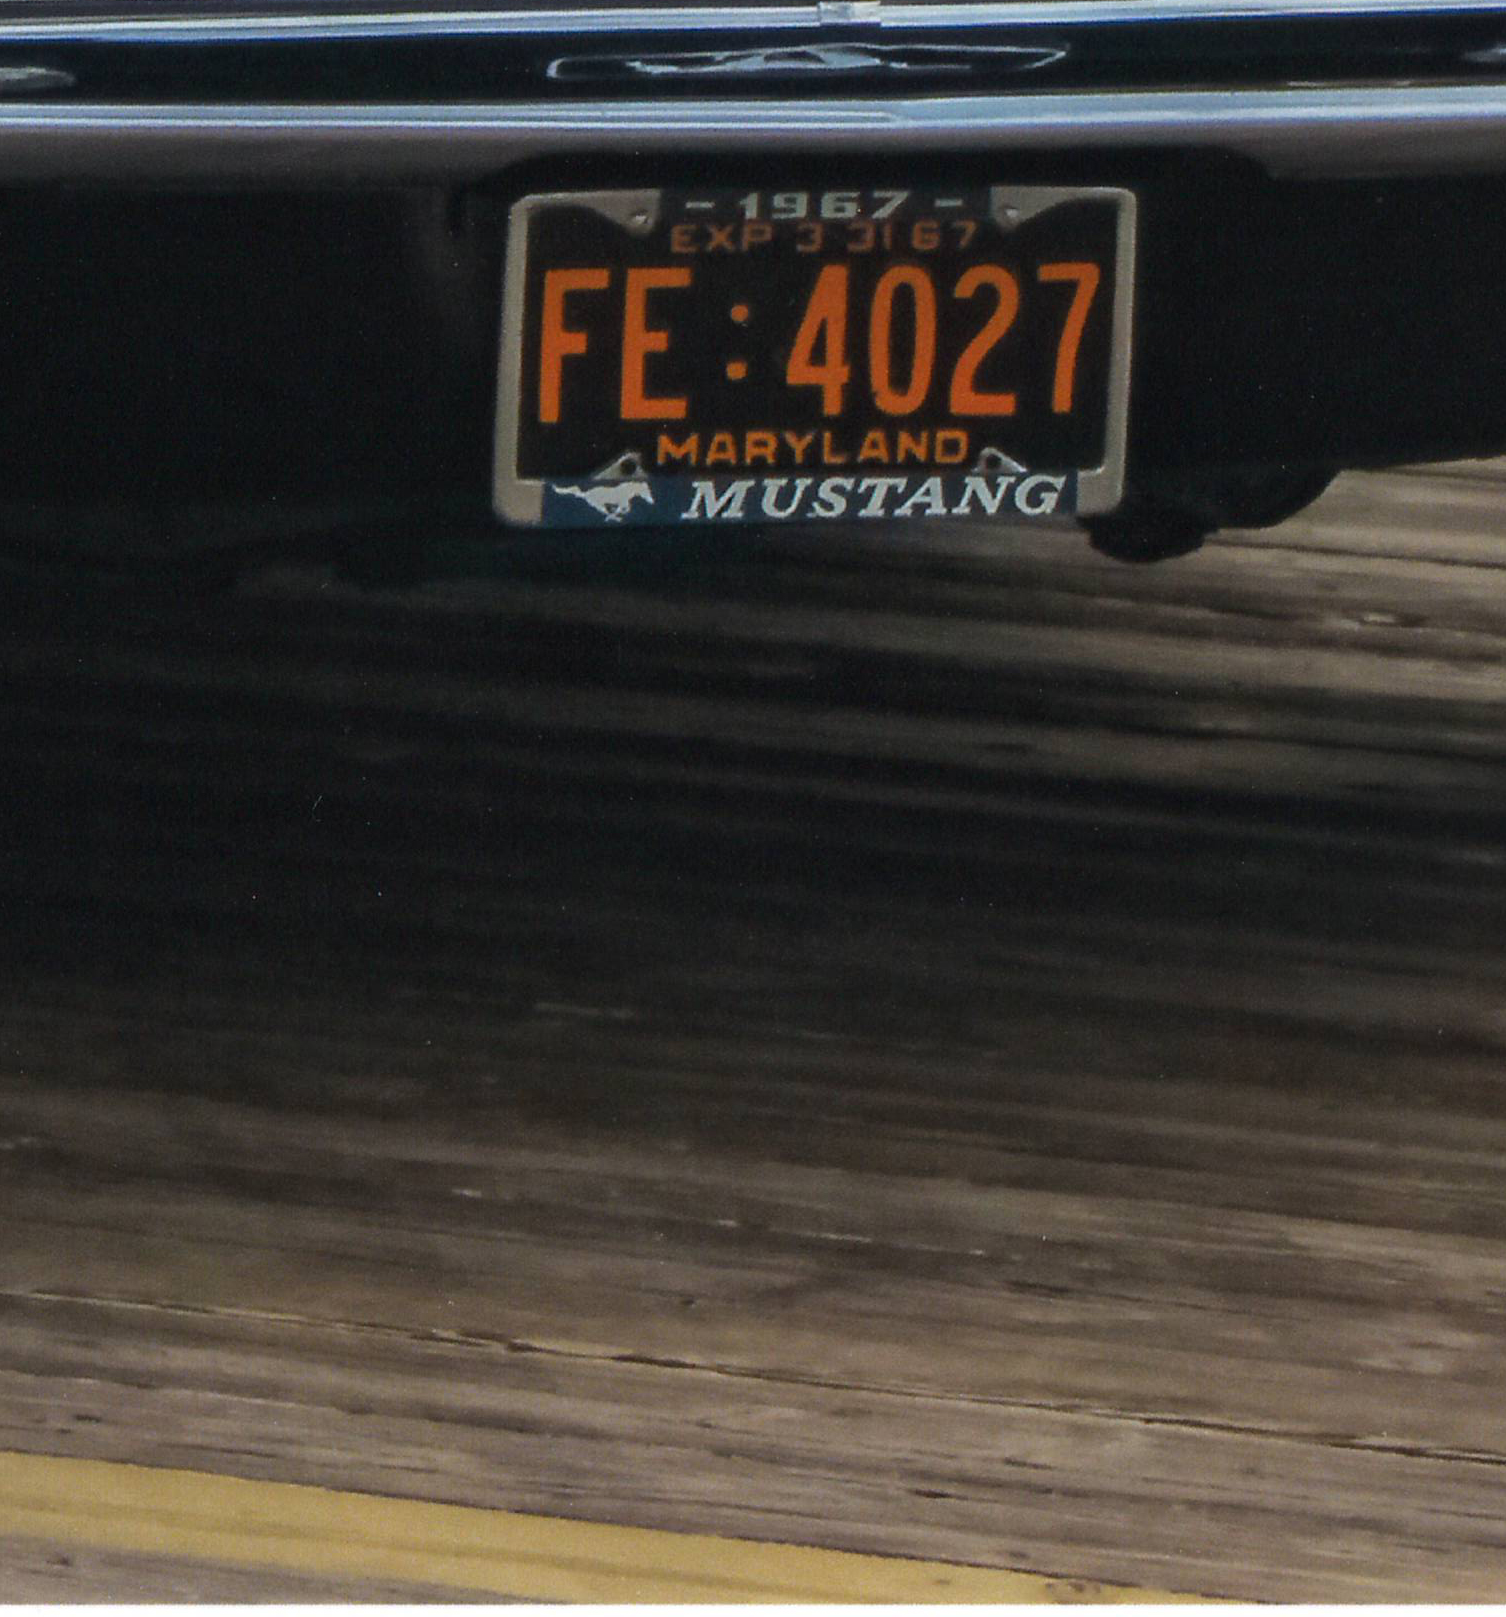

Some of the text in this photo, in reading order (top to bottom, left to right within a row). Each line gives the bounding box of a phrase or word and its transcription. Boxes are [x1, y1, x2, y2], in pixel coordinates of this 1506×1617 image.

[670, 221, 773, 254] EXP
[656, 429, 970, 467] MARYLAND
[680, 473, 1069, 520] MUSTANG
